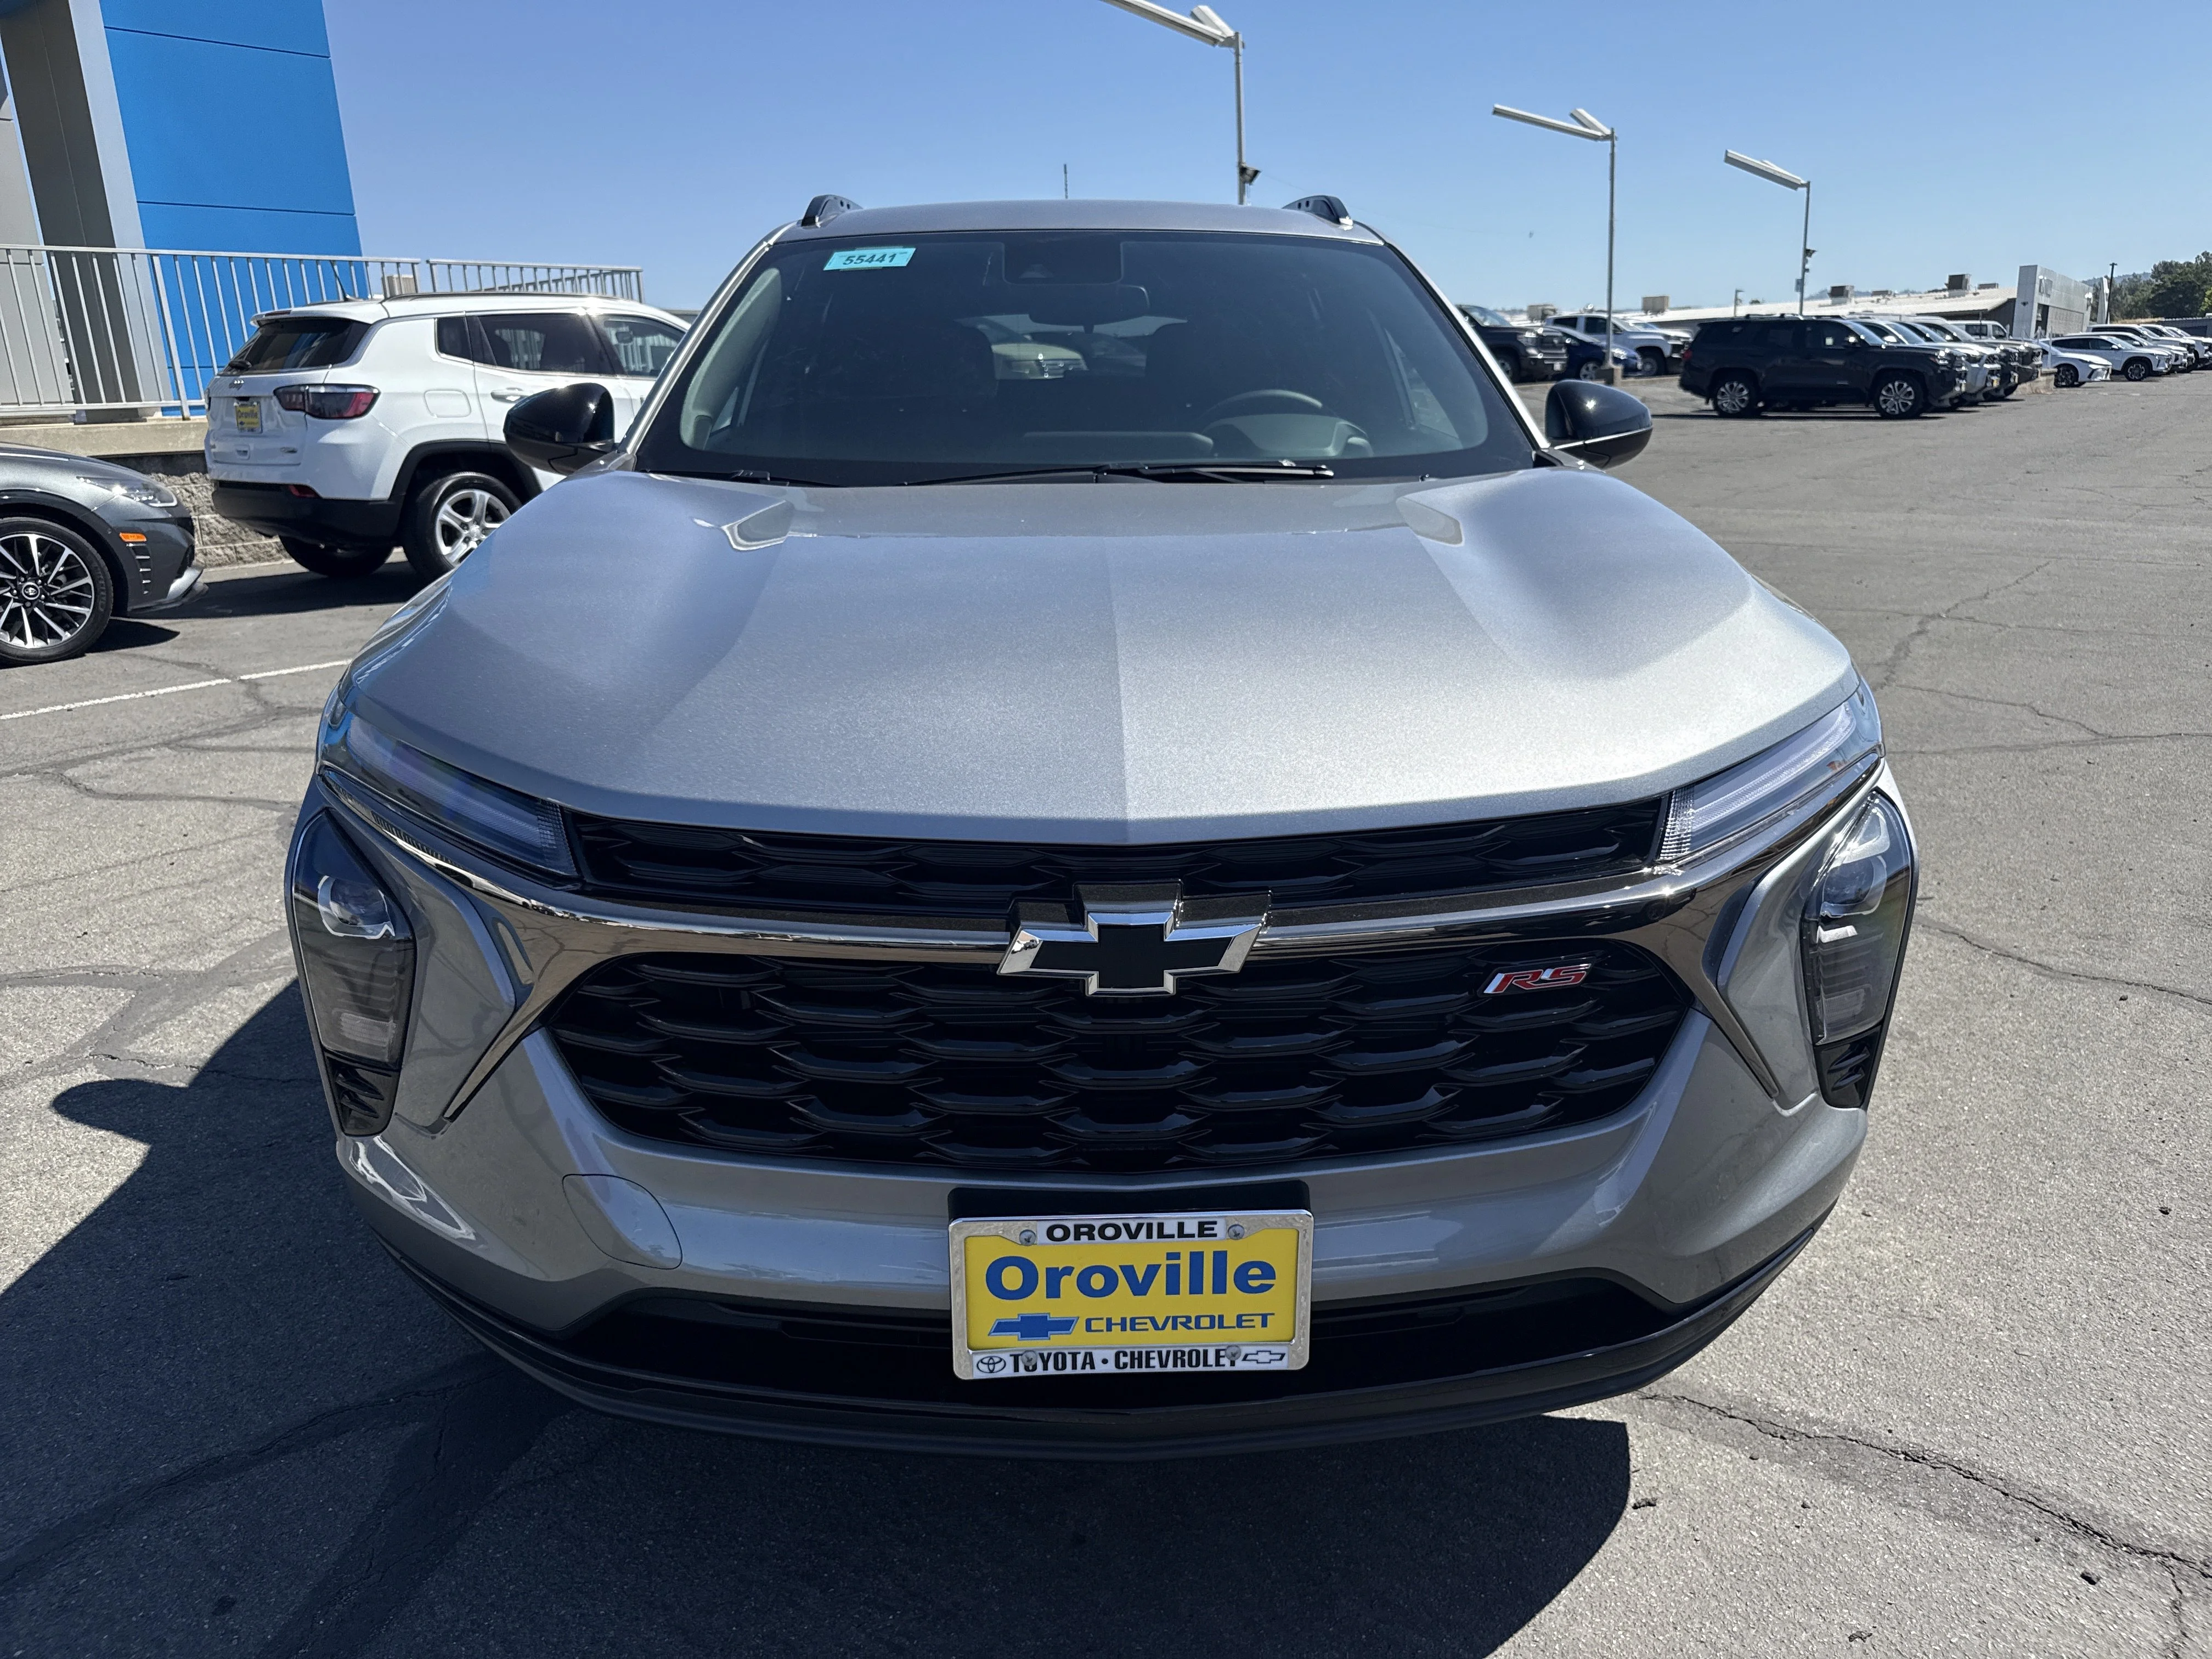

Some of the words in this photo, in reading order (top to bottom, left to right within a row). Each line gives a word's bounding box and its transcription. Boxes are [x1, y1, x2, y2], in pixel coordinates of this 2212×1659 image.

[843, 253, 896, 265] 55441
[1483, 963, 1592, 994] RS
[1046, 1220, 1217, 1242] OROVILLE
[985, 1250, 1276, 1300] Oroville
[1085, 1312, 1276, 1333] CHEVROLET
